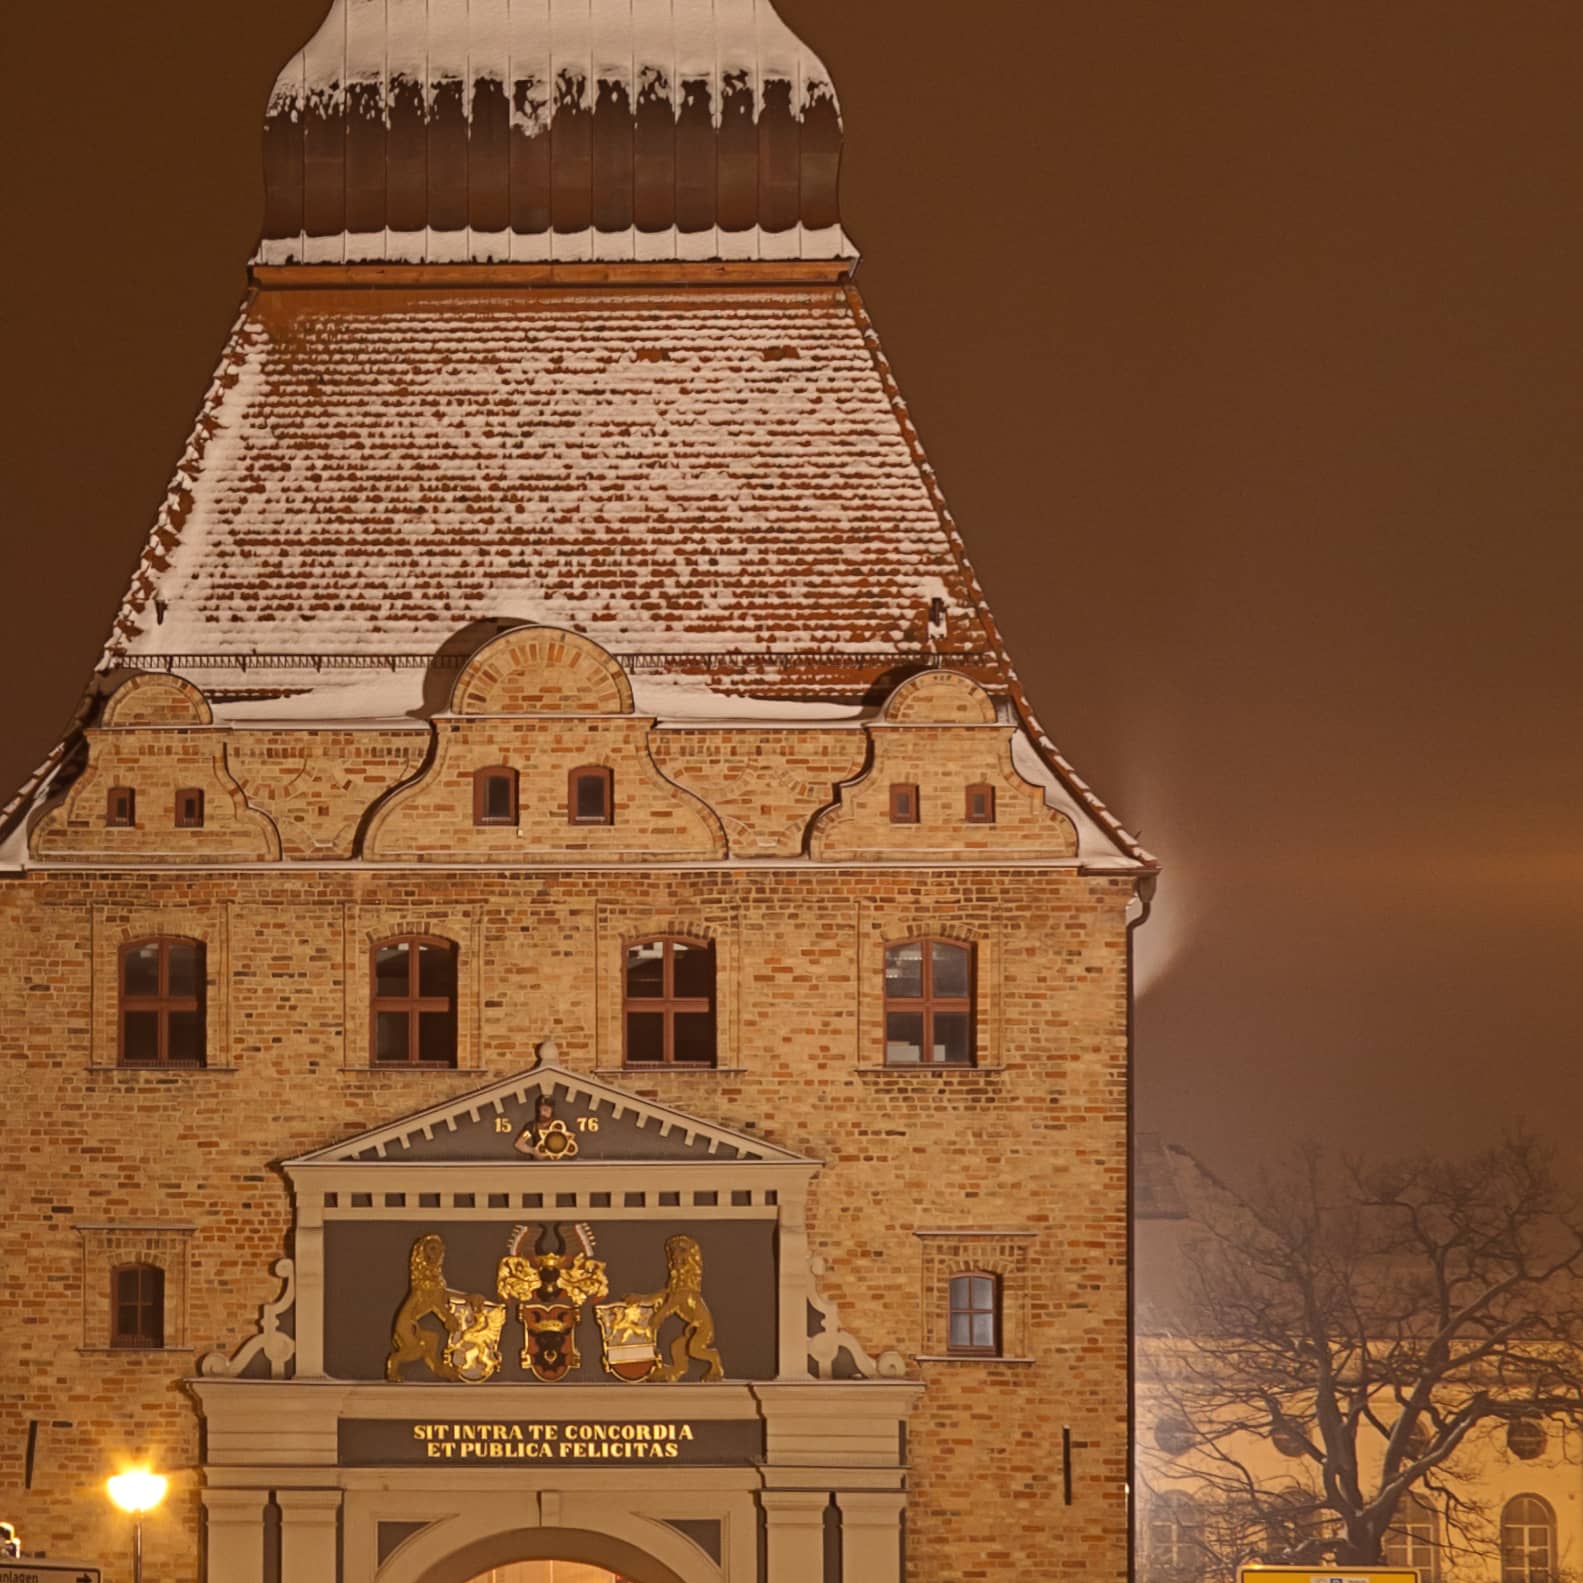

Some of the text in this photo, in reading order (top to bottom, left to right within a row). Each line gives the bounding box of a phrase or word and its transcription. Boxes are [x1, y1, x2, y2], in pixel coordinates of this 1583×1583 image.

[495, 1118, 599, 1133] 15 76
[414, 1424, 694, 1440] SIT INTRA TE CONCORDIA
[427, 1442, 678, 1458] ET PUBLICA FELICITAS
